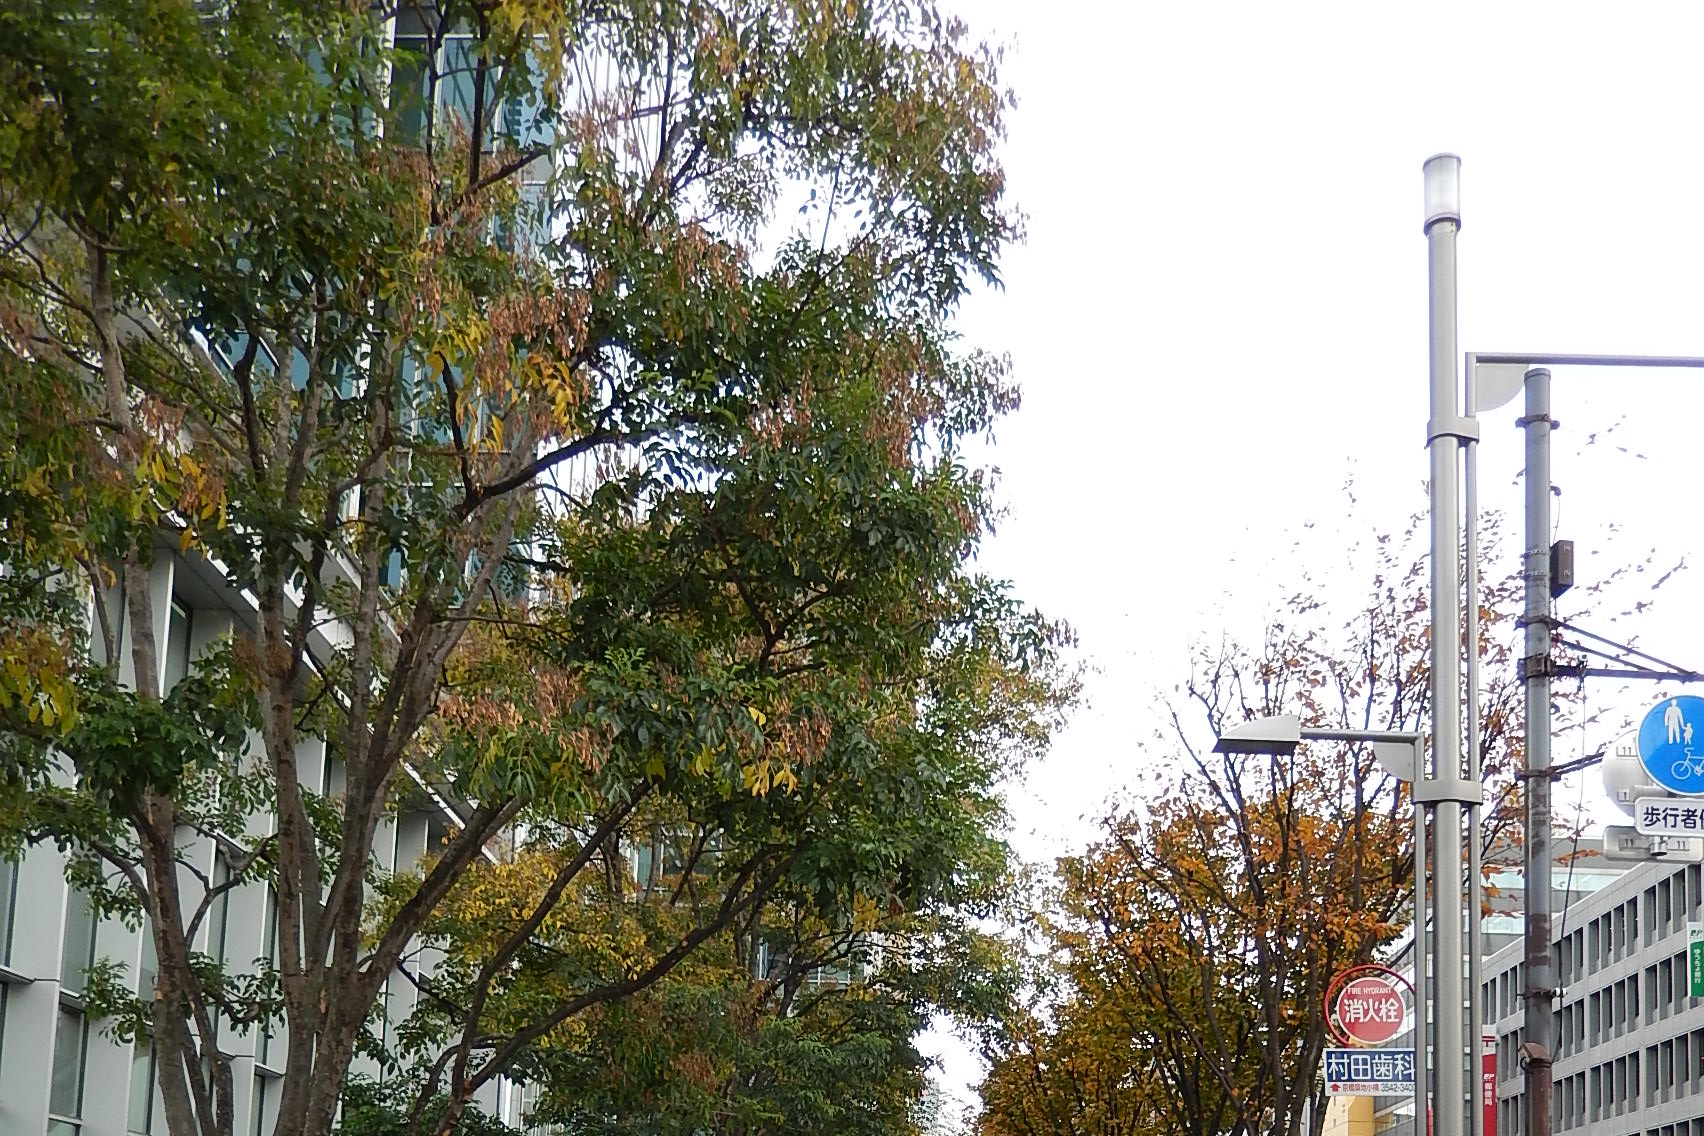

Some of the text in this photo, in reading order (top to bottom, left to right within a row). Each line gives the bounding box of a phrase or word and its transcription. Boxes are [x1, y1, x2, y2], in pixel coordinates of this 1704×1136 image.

[1347, 987, 1391, 995] FIRE HYDRANT
[1343, 997, 1400, 1023] 消火栓
[1328, 1053, 1415, 1081] 村田歯科
